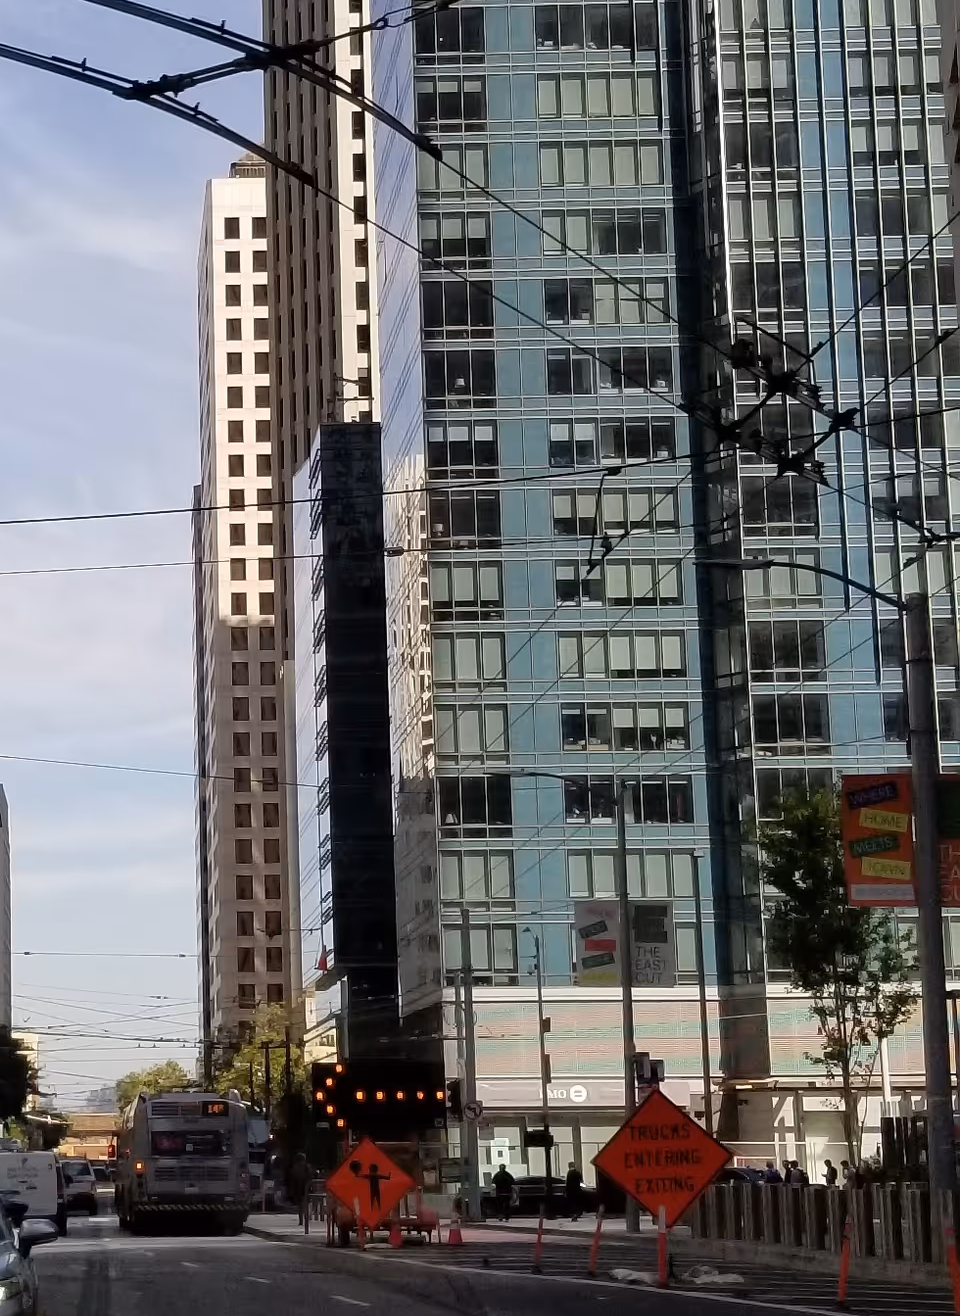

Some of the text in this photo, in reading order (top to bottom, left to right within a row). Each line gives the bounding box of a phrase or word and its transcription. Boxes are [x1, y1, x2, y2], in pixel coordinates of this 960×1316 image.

[849, 784, 894, 805] WHERE
[864, 814, 903, 828] HOME
[854, 836, 893, 853] MEETS
[937, 844, 960, 861] TH
[636, 946, 660, 958] THE
[635, 959, 665, 971] EAST
[635, 972, 662, 984] CUT
[629, 1124, 690, 1141] TRUCKS
[624, 1147, 702, 1169] ENTERING
[635, 1176, 695, 1194] EXITING
